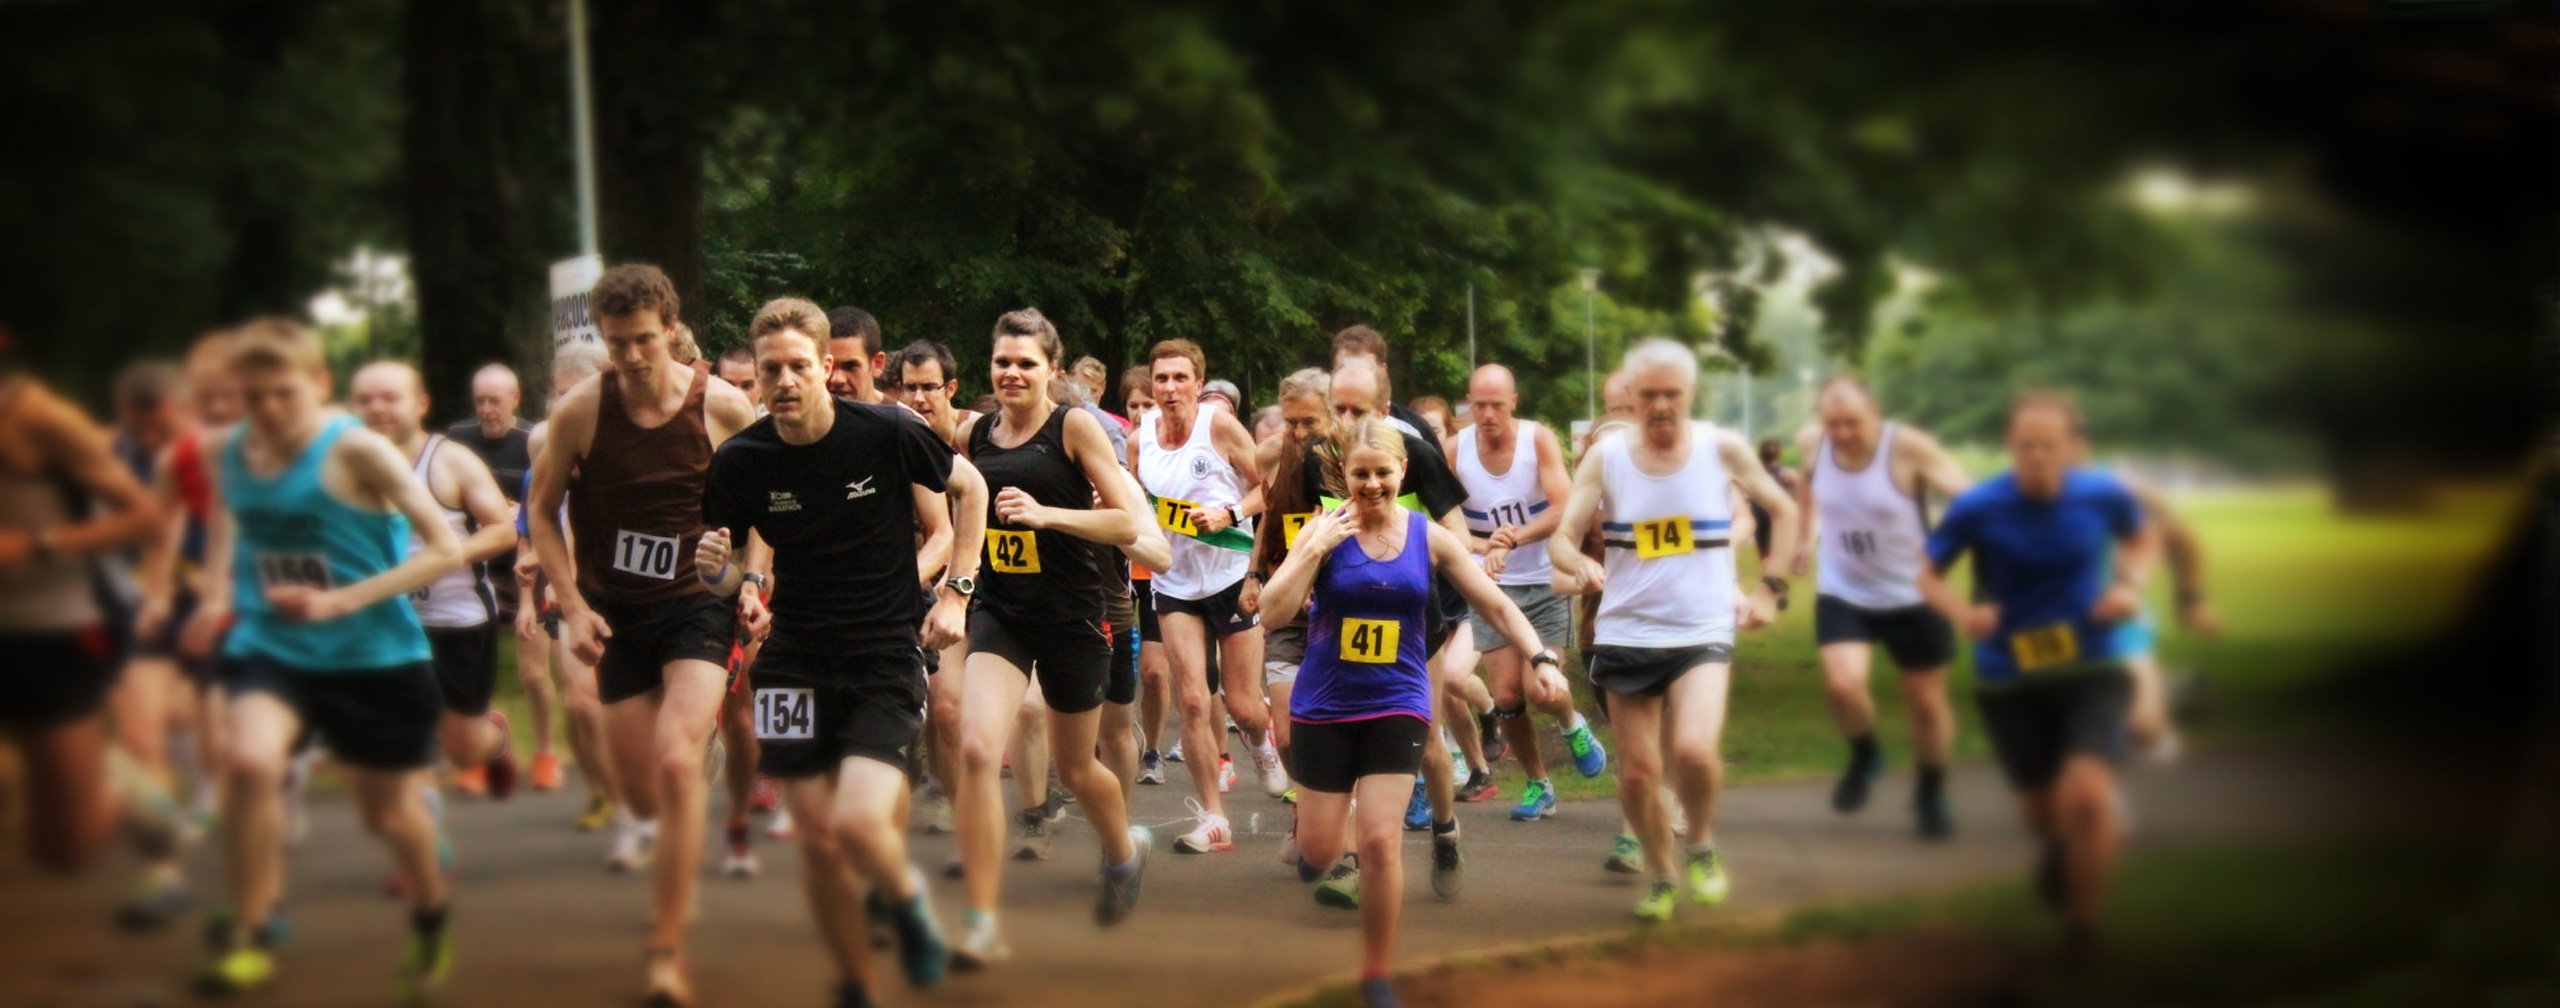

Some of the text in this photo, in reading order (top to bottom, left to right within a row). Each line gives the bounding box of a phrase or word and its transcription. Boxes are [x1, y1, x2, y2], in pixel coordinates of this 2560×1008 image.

[1167, 501, 1192, 528] 77
[1490, 502, 1526, 528] 171
[997, 535, 1027, 567] 42
[1644, 521, 1681, 550] 74
[623, 534, 674, 575] 170
[1351, 624, 1383, 656] 41
[759, 693, 809, 734] 154
